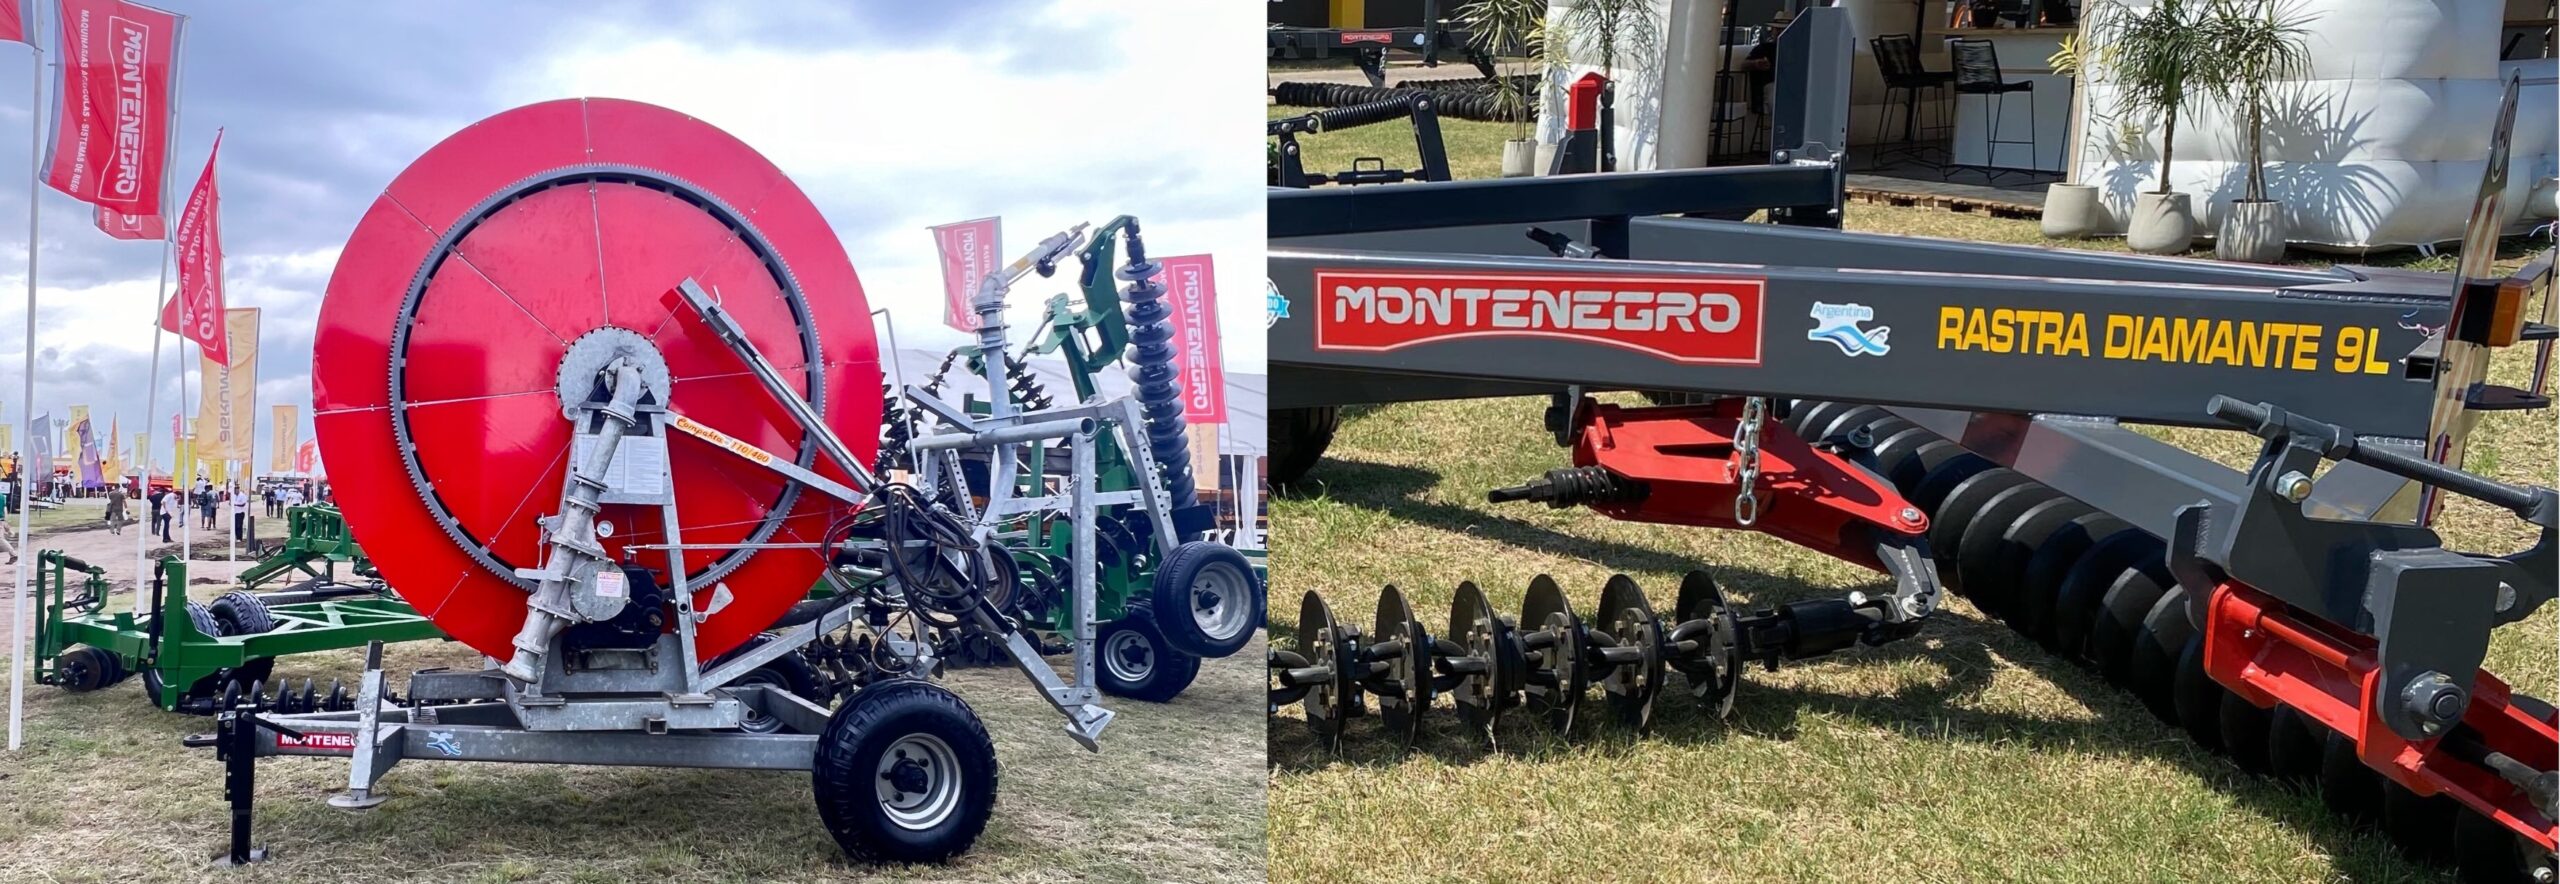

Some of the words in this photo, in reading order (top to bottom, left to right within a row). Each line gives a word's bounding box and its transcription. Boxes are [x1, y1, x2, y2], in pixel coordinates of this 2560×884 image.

[115, 27, 143, 194] MONTENEGRO
[77, 123, 90, 162] SISTEMAS
[69, 173, 81, 193] RIEGO
[74, 163, 83, 173] DE
[179, 188, 207, 242] SISTEMAS
[1335, 285, 1741, 334] MONTENEGRO
[1813, 304, 1871, 319] Argentina
[1183, 271, 1209, 410] MONTENEGRO
[1937, 306, 2091, 358] RASTRA
[2103, 314, 2323, 372] DIAMANTE
[2334, 326, 2390, 375] 9L
[676, 418, 723, 444] Compakta
[730, 442, 769, 463] 110/480
